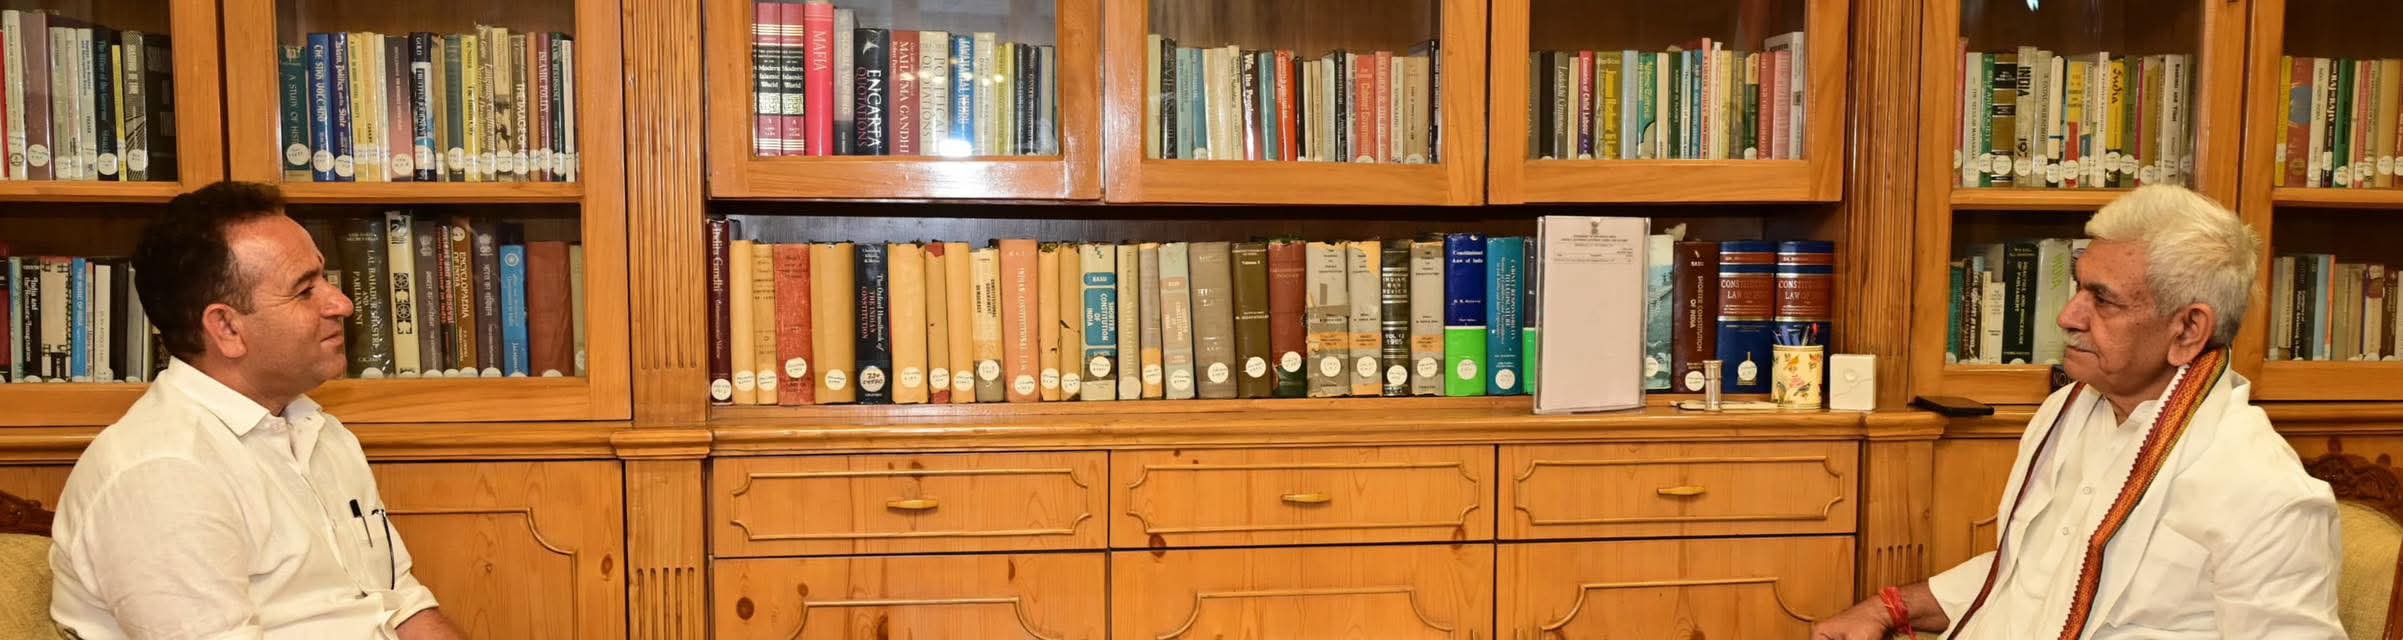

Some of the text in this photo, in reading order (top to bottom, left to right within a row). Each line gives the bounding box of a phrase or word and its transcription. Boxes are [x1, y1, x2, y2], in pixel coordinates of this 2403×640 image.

[812, 31, 827, 70] MAFIA
[958, 38, 971, 93] JAWAHALAL
[334, 65, 346, 91] Politics
[516, 83, 526, 100] THE
[538, 52, 549, 112] ISLAMIC POLITY
[842, 70, 851, 114] WARNING
[1245, 74, 1254, 86] the
[2017, 67, 2032, 97] INDIA
[2112, 69, 2123, 104] India
[288, 84, 298, 106] STUDY
[316, 83, 328, 121] VOLCANO
[856, 66, 867, 147] QUOTATIONS
[866, 69, 882, 146] ENCARTA
[899, 42, 910, 153] MAHMA GANDHI
[934, 57, 946, 133] POITICAL
[1246, 89, 1254, 114] People
[1557, 66, 1568, 136] Ladakhi Grammar
[1582, 93, 1590, 110] Child
[2326, 75, 2338, 123] RAJ RAJIV
[290, 112, 298, 122] OF
[338, 108, 347, 127] State
[1582, 112, 1590, 135] Labour
[290, 126, 300, 144] HIST
[2016, 138, 2028, 160] 197
[712, 224, 724, 256] Indira
[444, 262, 452, 276] and
[454, 252, 461, 262] OF
[459, 252, 470, 318] ENCYCLOPAEDIA
[484, 282, 492, 291] का
[712, 257, 725, 292] Gandhi
[1017, 267, 1026, 293] INDIAN
[1506, 274, 1511, 282] TO
[1696, 276, 1704, 303] SHORTER
[30, 277, 40, 310] India and
[77, 302, 84, 310] OF
[352, 271, 363, 325] PARLIAMENT
[368, 250, 380, 347] LAL BAHADUR SHASTRI
[1690, 299, 1696, 307] OF
[1784, 290, 1800, 300] LAW
[2014, 272, 2022, 311] PARLIAMENT
[24, 277, 33, 361] the Romantic Imagination
[860, 286, 869, 338] CONSTITUTION
[868, 291, 877, 333] THE INDIAN
[876, 274, 885, 352] The Oxford Handbook of
[1017, 296, 1027, 351] CONSTITUTIONAL
[1086, 308, 1094, 326] INDIA
[1094, 313, 1101, 321] OF
[1100, 293, 1108, 341] CONSTITUTION
[1108, 302, 1116, 331] SHORTER
[1175, 301, 1184, 341] CONSTITUTION
[2018, 309, 2026, 344] PROCEDURE
